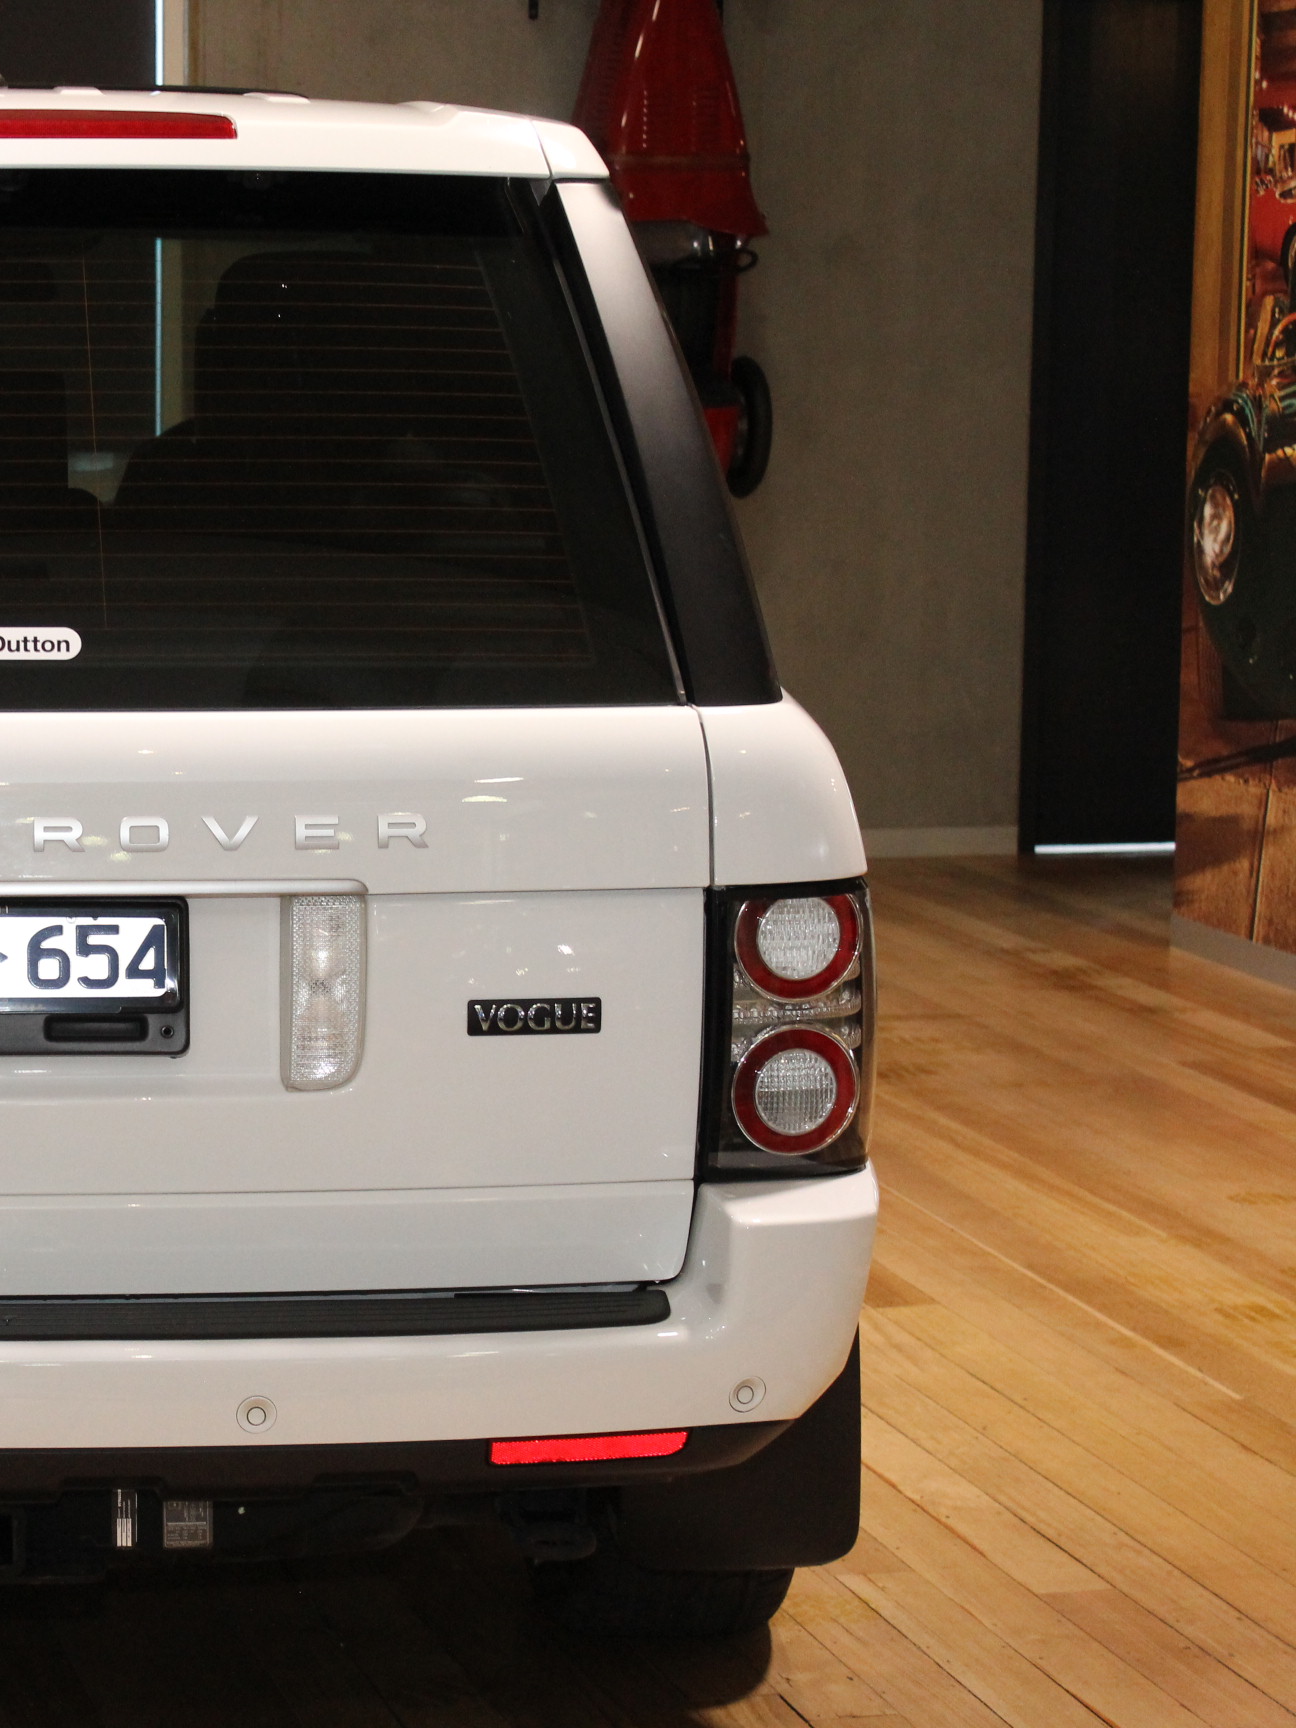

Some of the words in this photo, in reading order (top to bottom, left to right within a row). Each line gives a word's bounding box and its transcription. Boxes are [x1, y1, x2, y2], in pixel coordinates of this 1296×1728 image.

[33, 815, 430, 853] ROVER
[26, 923, 167, 990] 654
[473, 1002, 596, 1032] VOGUE
